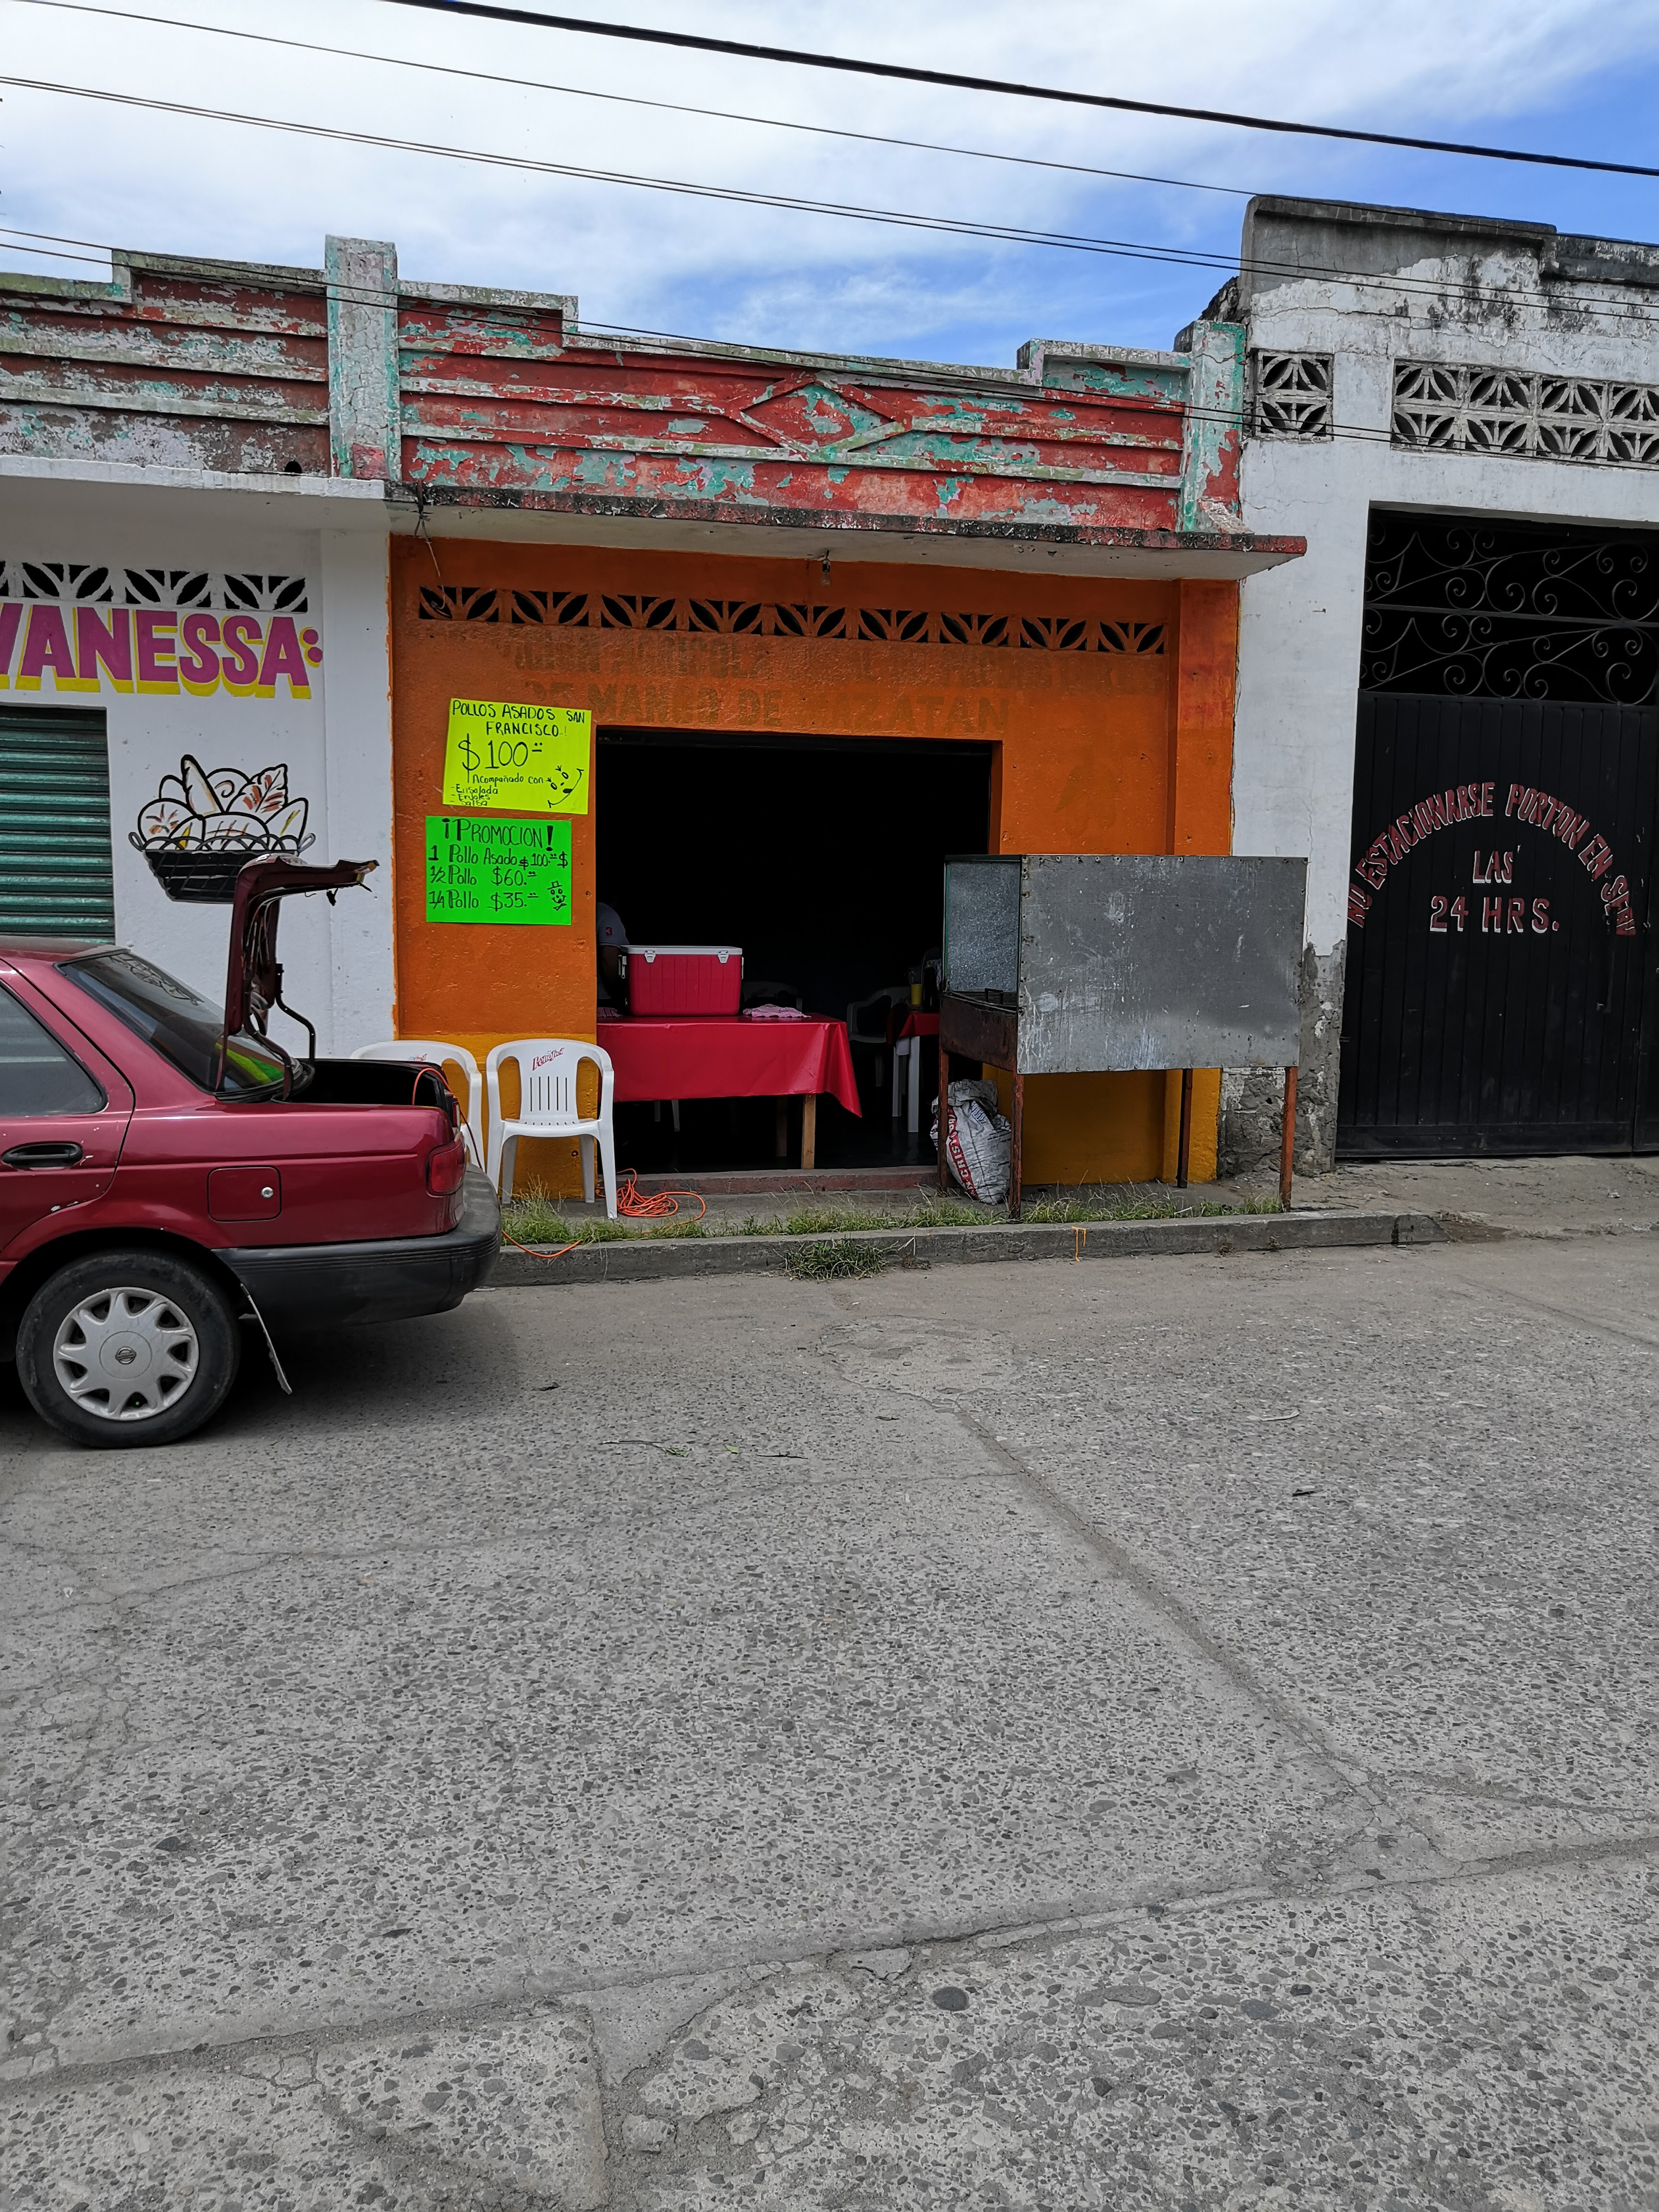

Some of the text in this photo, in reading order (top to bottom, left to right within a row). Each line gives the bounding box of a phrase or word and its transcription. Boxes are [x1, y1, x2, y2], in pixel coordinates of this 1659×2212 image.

[453, 700, 585, 724] POLLOS ASADOS SAN
[473, 773, 524, 787] Acompañado
[1505, 783, 1590, 850] PORTON
[1355, 782, 1495, 890] ESTACIONARSE
[428, 845, 439, 861] 1
[449, 844, 478, 864] Pollo
[483, 847, 517, 865] Asado
[1473, 850, 1513, 884] LAS
[1578, 834, 1613, 882] EN
[448, 865, 477, 885] Pollo
[446, 889, 479, 909] Pollo
[1347, 882, 1372, 929] NO
[1430, 896, 1560, 934] 24 HRS.
